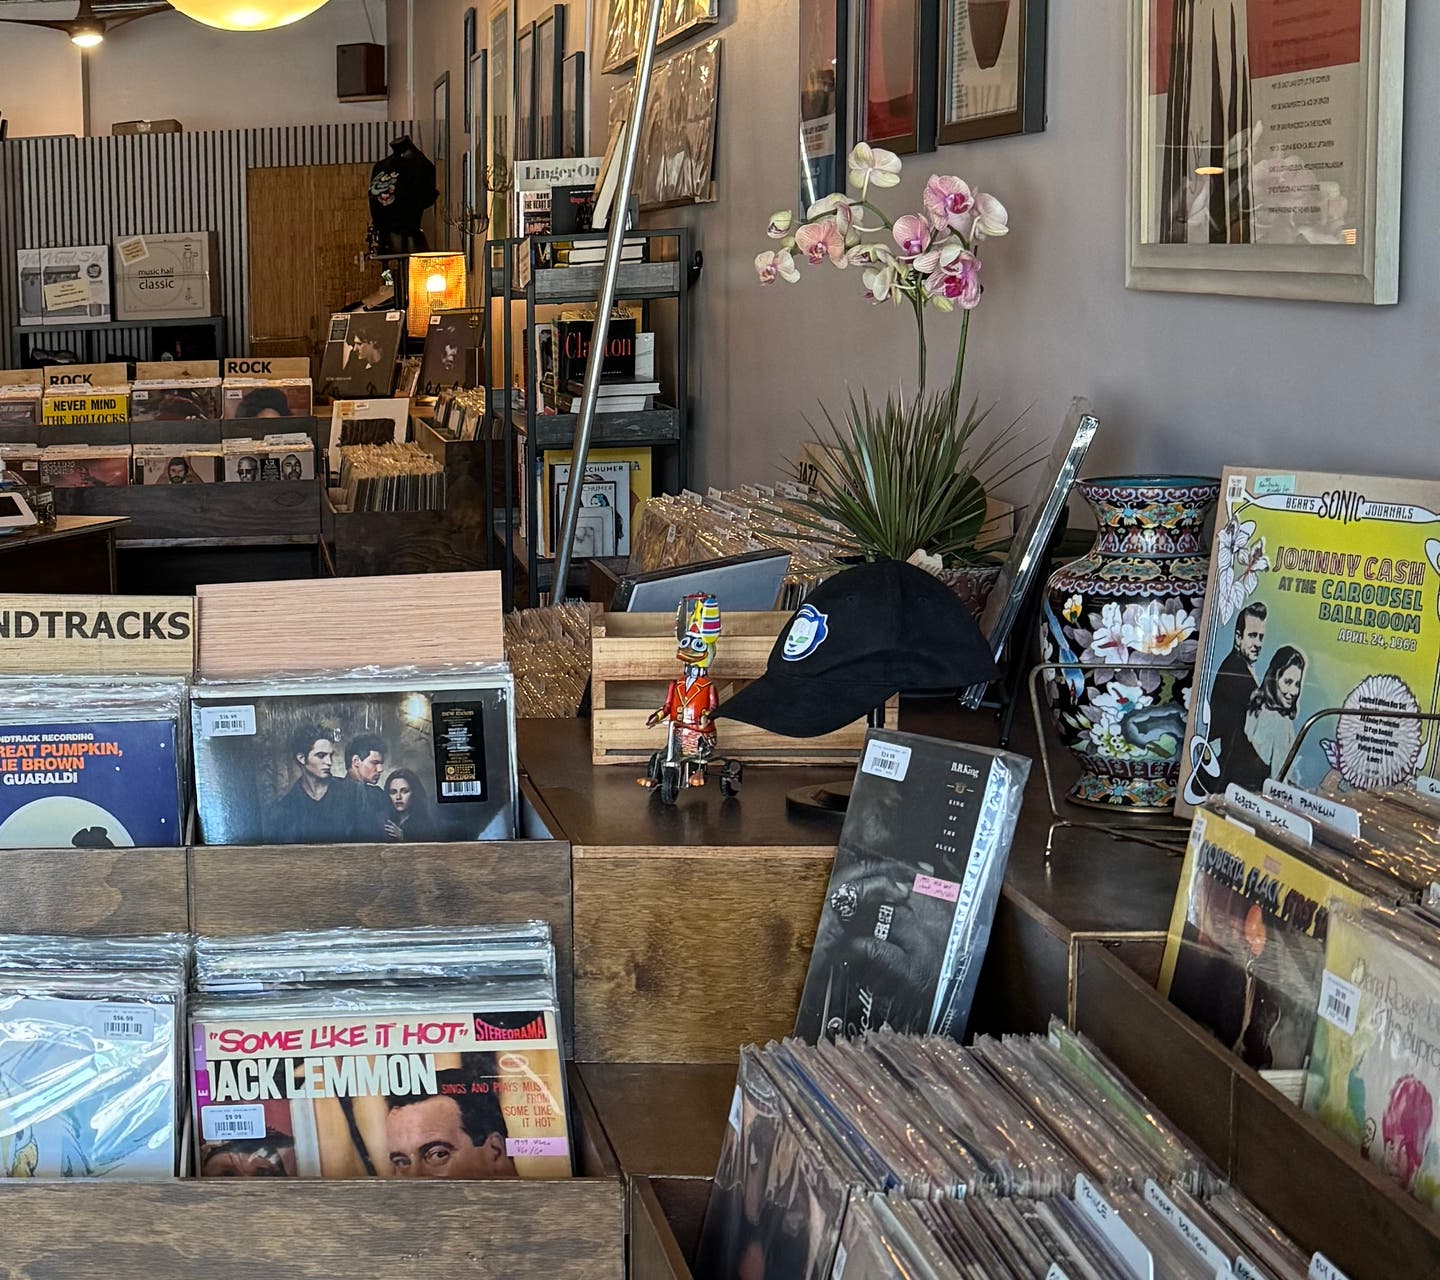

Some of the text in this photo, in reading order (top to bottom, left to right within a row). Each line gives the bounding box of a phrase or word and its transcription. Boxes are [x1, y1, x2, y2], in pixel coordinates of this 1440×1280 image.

[525, 163, 600, 182] Linger On
[138, 267, 174, 277] music hall
[139, 277, 175, 290] classic
[564, 331, 632, 360] Claton
[227, 361, 272, 374] ROCK
[49, 373, 93, 386] ROCK
[53, 398, 116, 412] NEVER MIND
[46, 413, 68, 425] THE
[1285, 490, 1415, 524] BEAR'S SONIC JOURNALS
[1272, 547, 1426, 586] JOHNNY CASH
[1278, 575, 1423, 612] AT THE CAROUSEL
[1318, 603, 1422, 634] BALLROOM
[1338, 629, 1368, 644] APRIL
[1371, 635, 1389, 650] 24,
[41, 732, 94, 742] RECORDING
[40, 741, 123, 758] PUMPKIN,
[22, 756, 85, 772] BROWN
[3, 770, 79, 786] GUARALDI
[1197, 839, 1247, 886] ROBERTA
[475, 1015, 546, 1041] STEREORAMA
[209, 1027, 304, 1054] "SOME
[309, 1024, 368, 1051] LIKE
[402, 1021, 469, 1045] HOT"
[207, 1053, 439, 1103] JACK LEMMON
[441, 1083, 467, 1095] SINGS
[471, 1082, 489, 1094] AND
[522, 1081, 549, 1093] MUS
[526, 1093, 550, 1104] FROM
[534, 1105, 552, 1116] LIKE
[522, 1117, 530, 1128] IT
